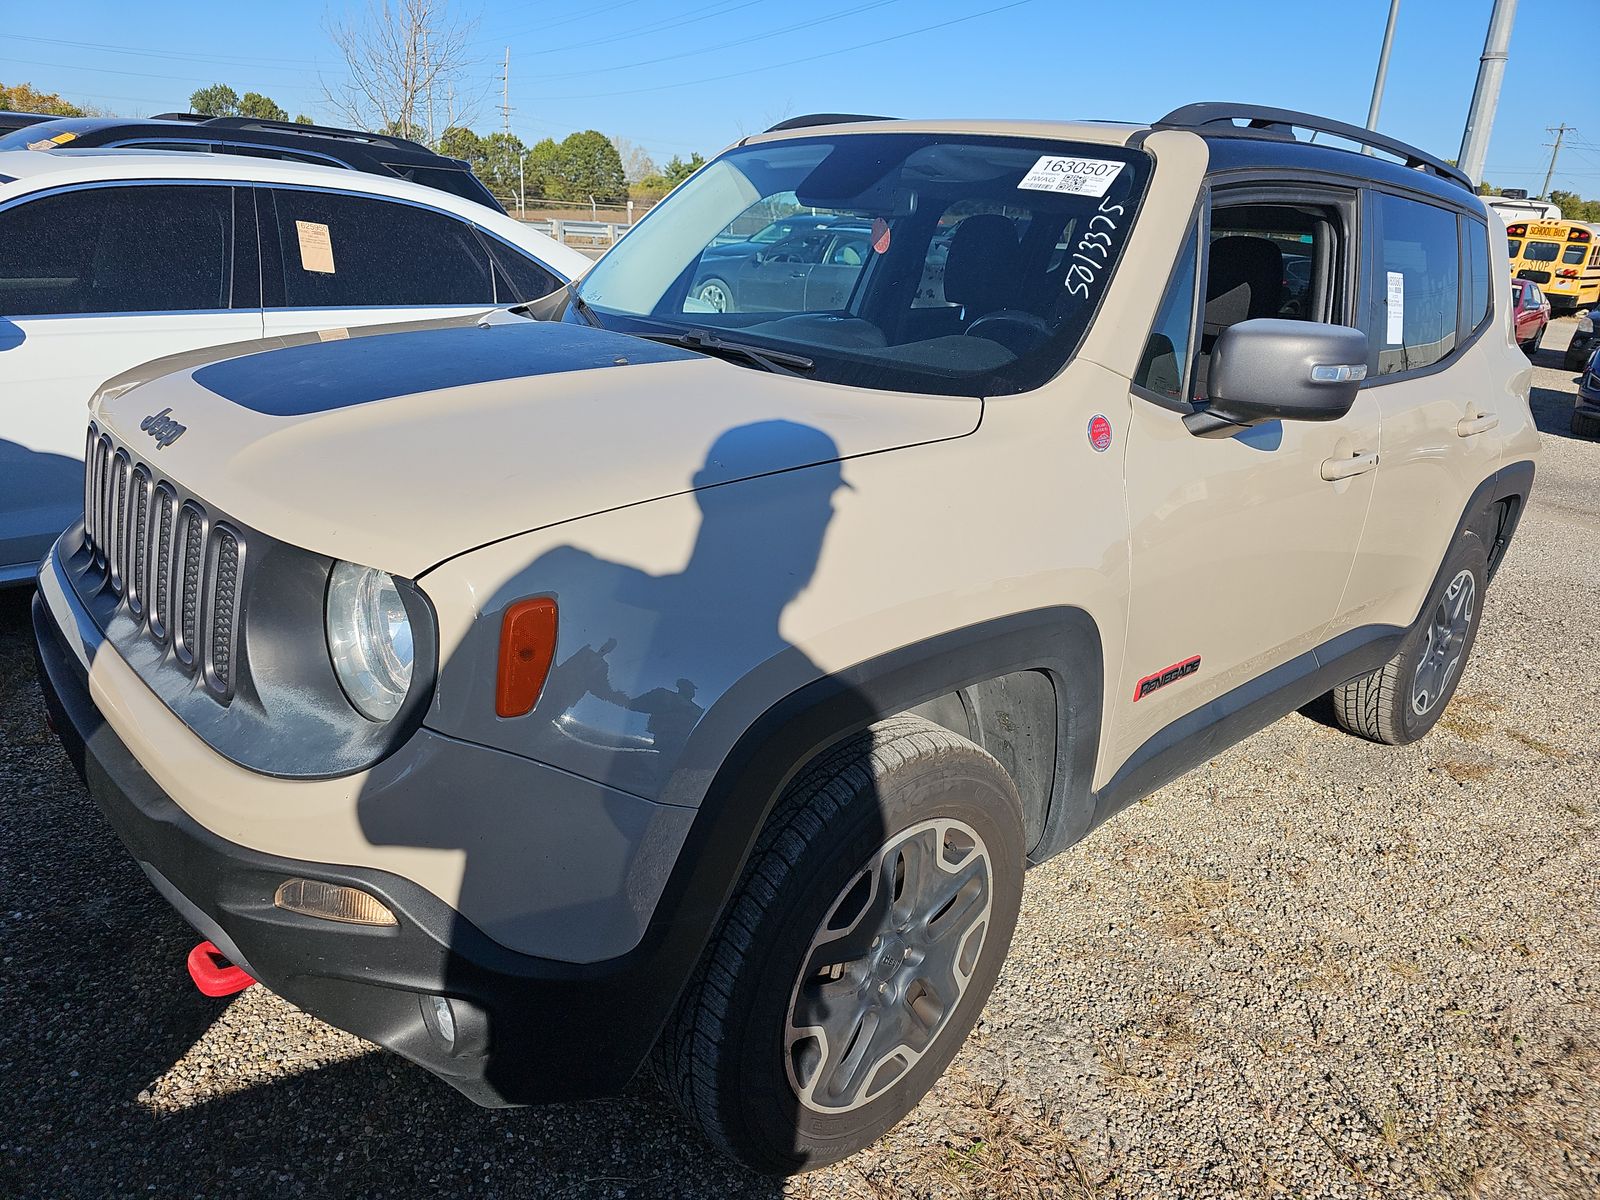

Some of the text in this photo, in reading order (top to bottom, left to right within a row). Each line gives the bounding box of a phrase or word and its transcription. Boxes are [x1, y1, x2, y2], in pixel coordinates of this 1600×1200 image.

[1043, 159, 1121, 177] 1630507
[1529, 226, 1567, 237] SCHOOL BUS
[1528, 260, 1550, 271] STOP
[1139, 657, 1201, 698] RENEGADE
